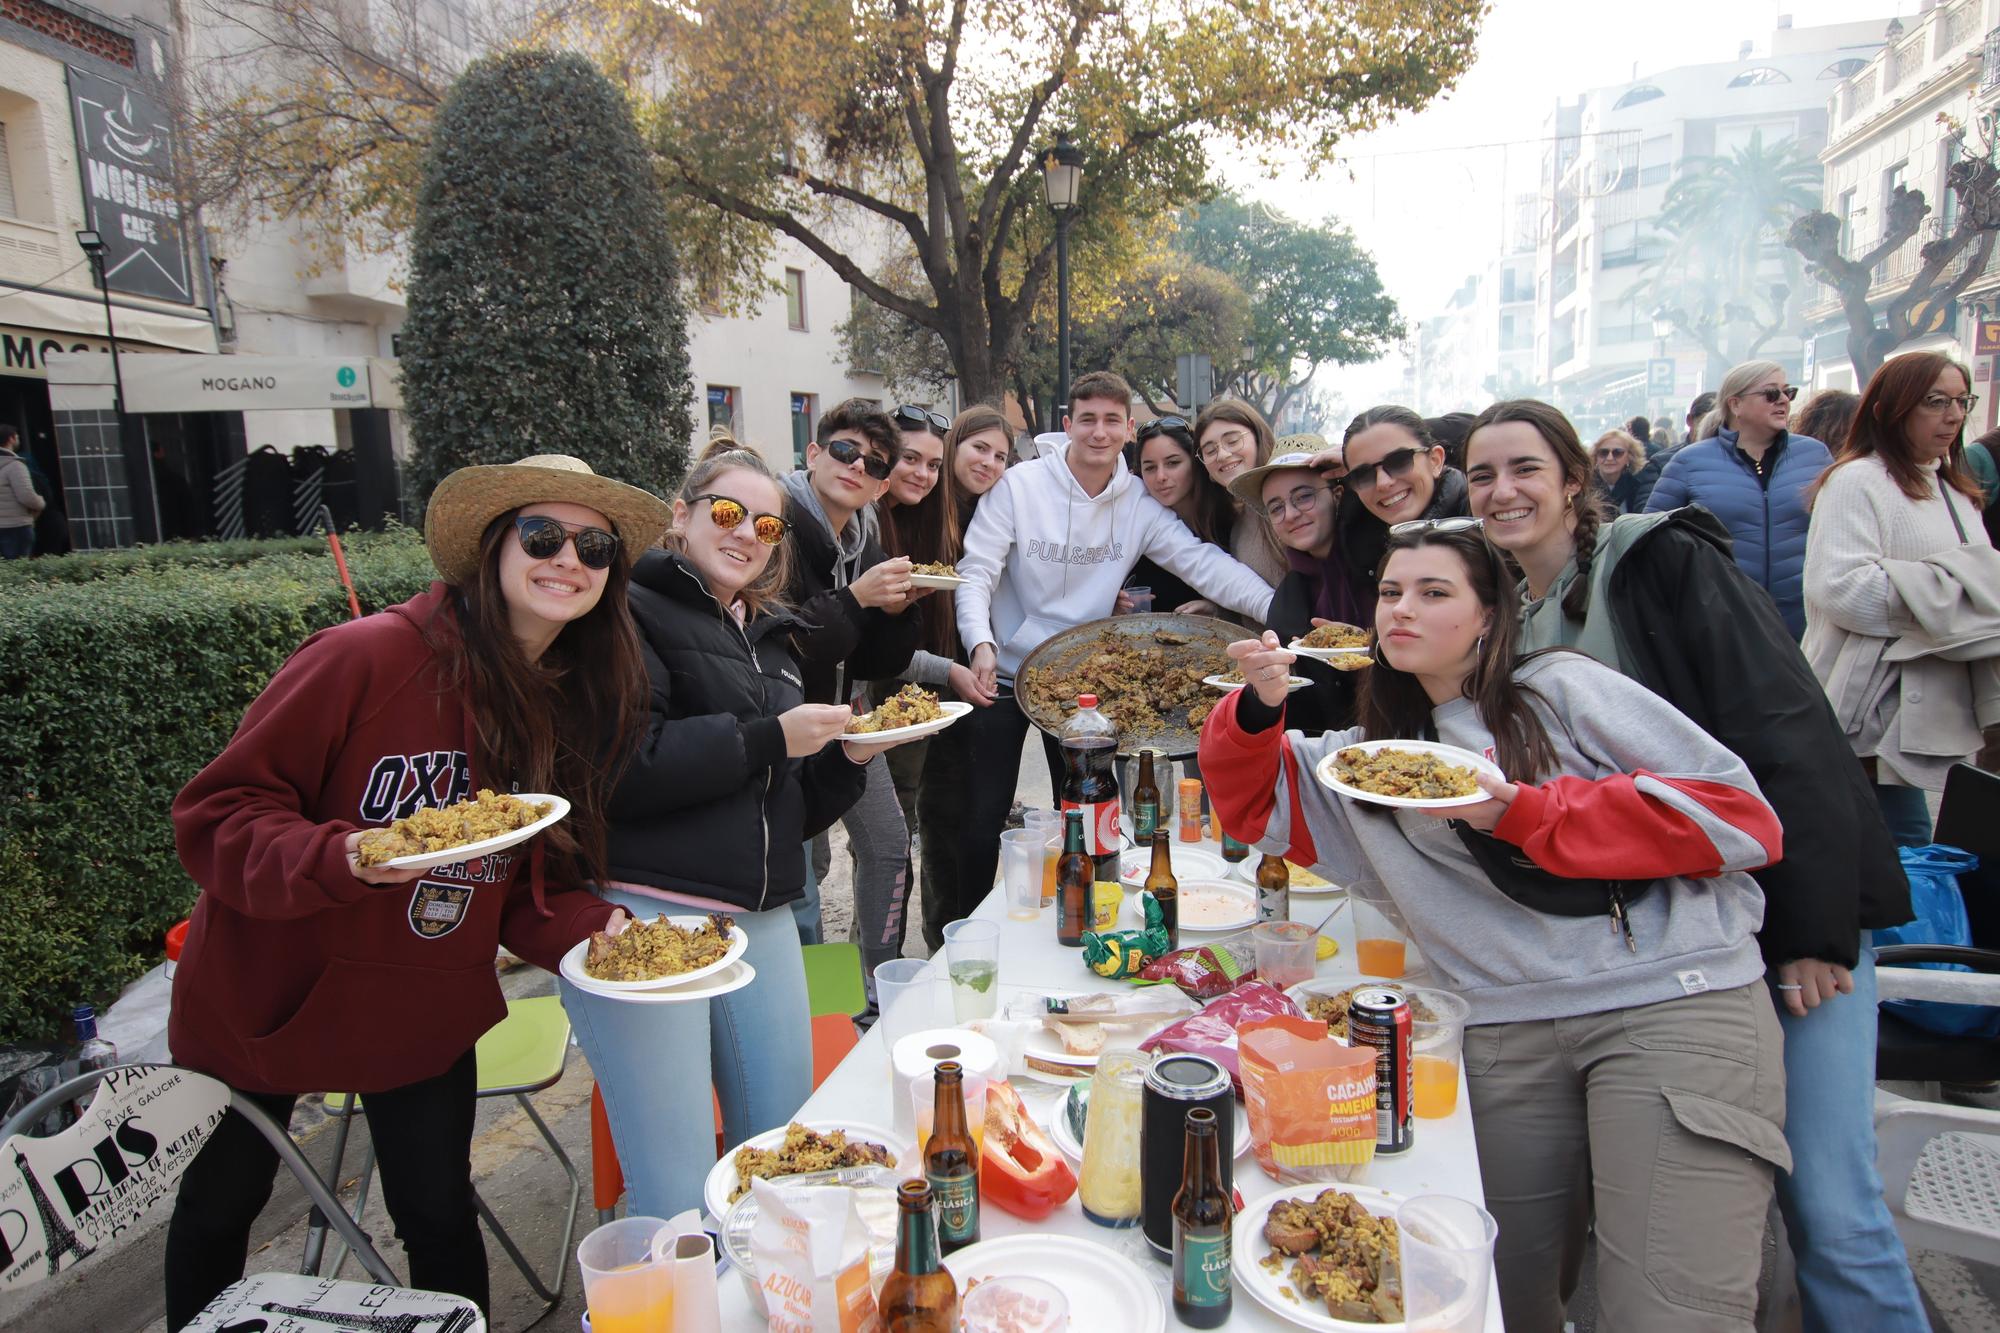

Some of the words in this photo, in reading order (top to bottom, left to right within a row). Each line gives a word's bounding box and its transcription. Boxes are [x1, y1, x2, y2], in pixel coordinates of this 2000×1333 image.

[202, 376, 277, 391] MOGANO
[1654, 363, 1670, 385] P
[1027, 539, 1125, 565] PULL&BEAR
[104, 1105, 134, 1132] RIVE
[138, 1074, 182, 1106] GAUCHE
[75, 1171, 144, 1230] CATHEDRAL
[148, 1154, 162, 1172] OF
[165, 1124, 203, 1158] NOTRE
[140, 1174, 157, 1194] de
[136, 1183, 167, 1208] EIFFEL
[783, 1301, 810, 1319] Blanco
